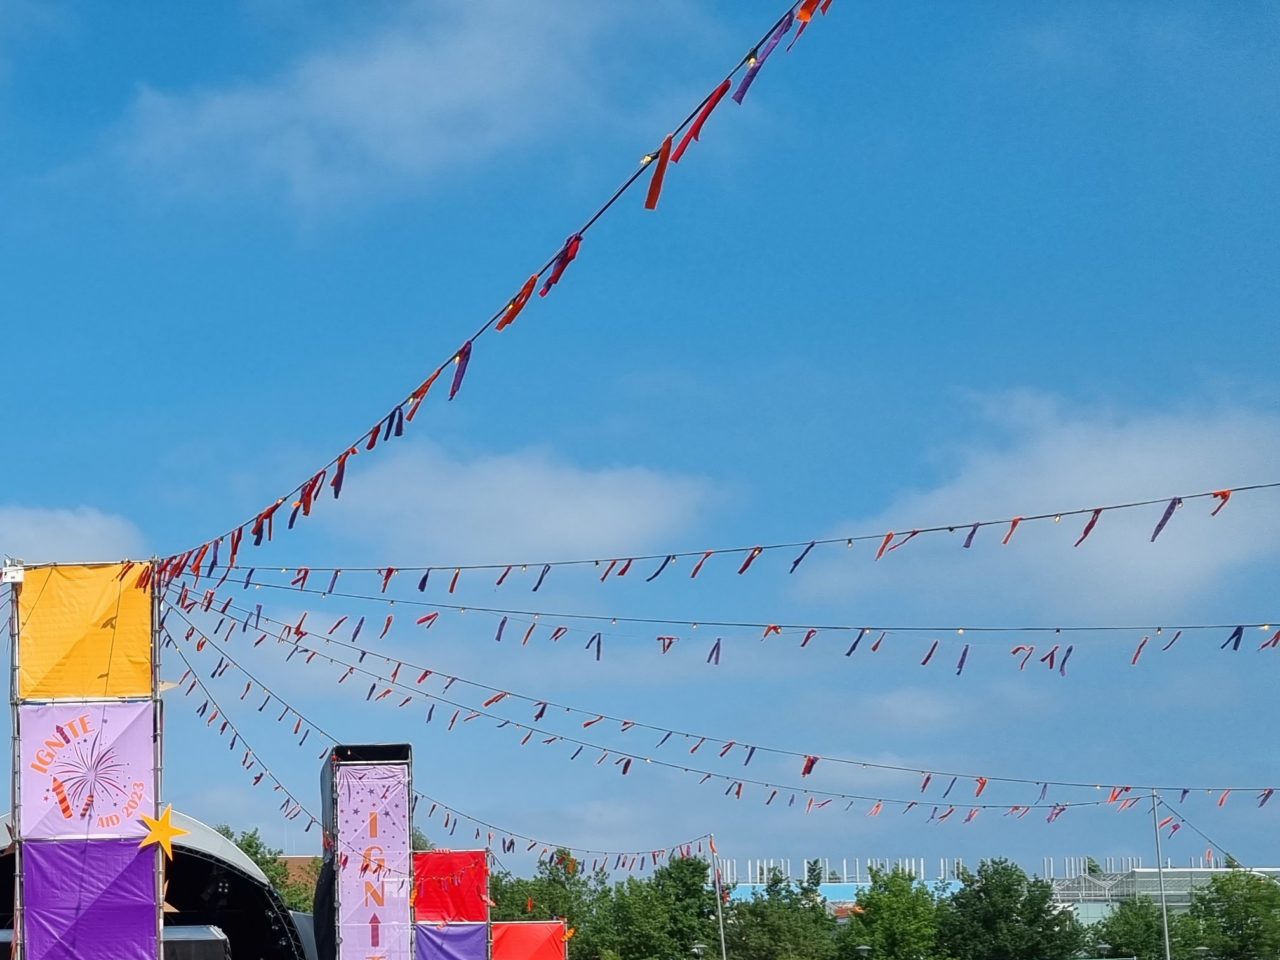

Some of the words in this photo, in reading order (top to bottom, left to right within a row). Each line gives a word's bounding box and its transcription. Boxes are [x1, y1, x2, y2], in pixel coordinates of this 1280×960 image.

[30, 714, 95, 774] IGNITE
[96, 814, 121, 829] AID
[122, 781, 145, 818] 2023
